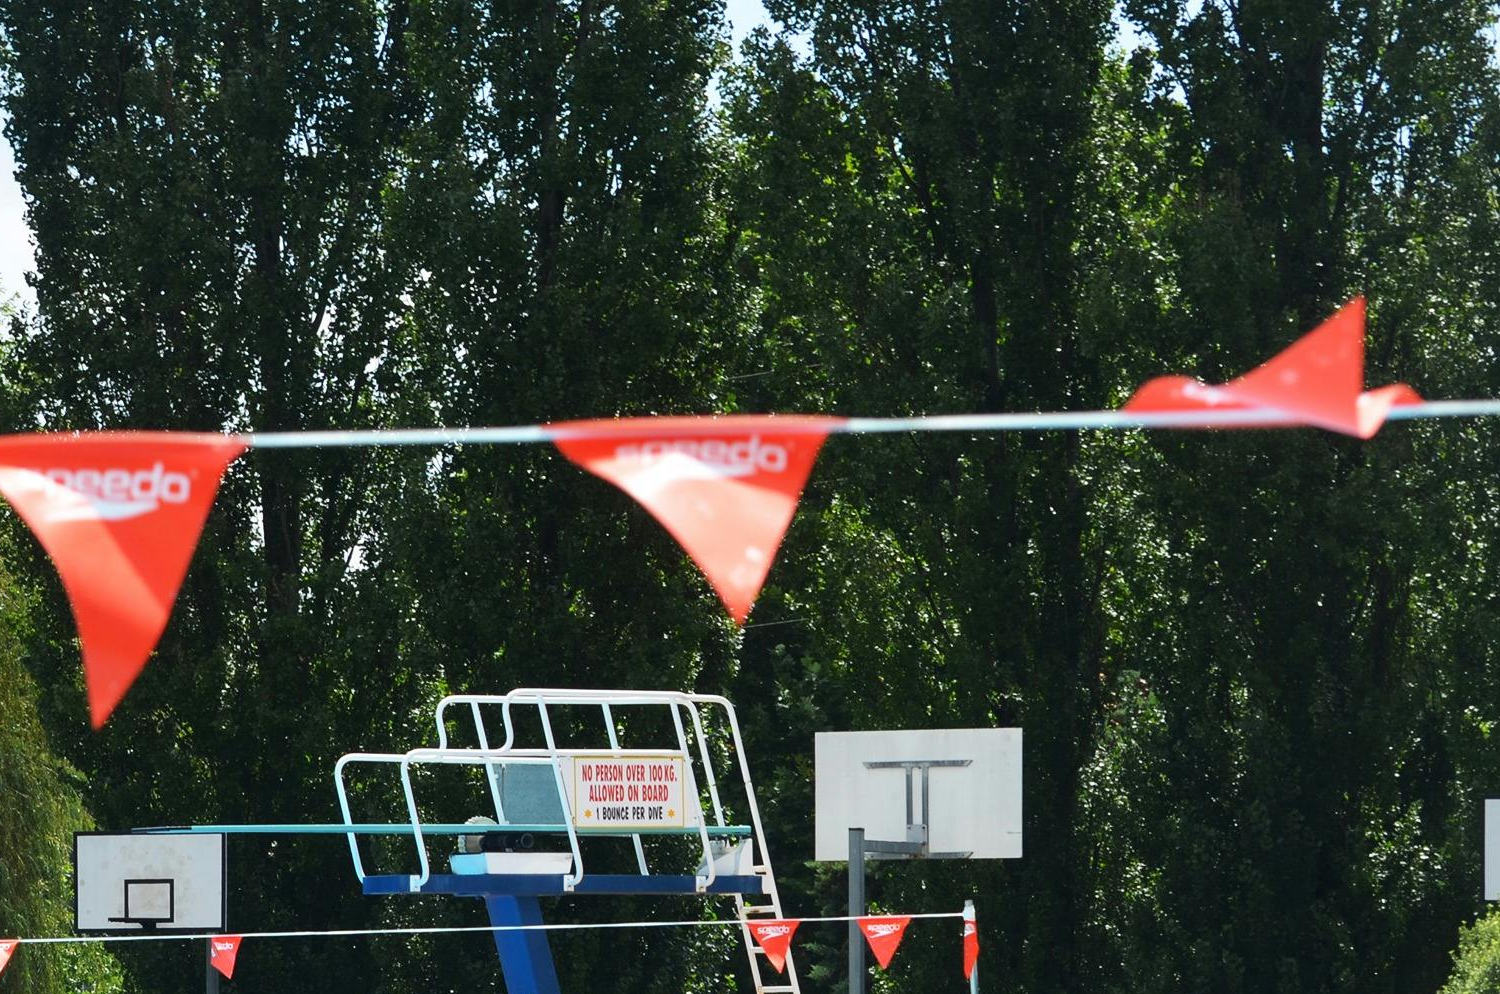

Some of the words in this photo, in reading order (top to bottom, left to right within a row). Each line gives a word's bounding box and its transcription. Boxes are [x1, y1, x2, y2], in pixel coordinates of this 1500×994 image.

[18, 461, 191, 504] peedo
[581, 764, 592, 782] NO
[595, 764, 623, 782] PERSON
[626, 764, 646, 782] OVER
[589, 784, 625, 802] ALLOWED
[628, 784, 640, 802] ON
[642, 784, 669, 802] BOARD
[602, 807, 629, 820] BOUNCE
[632, 807, 646, 820] PER
[648, 806, 663, 820] DIVE
